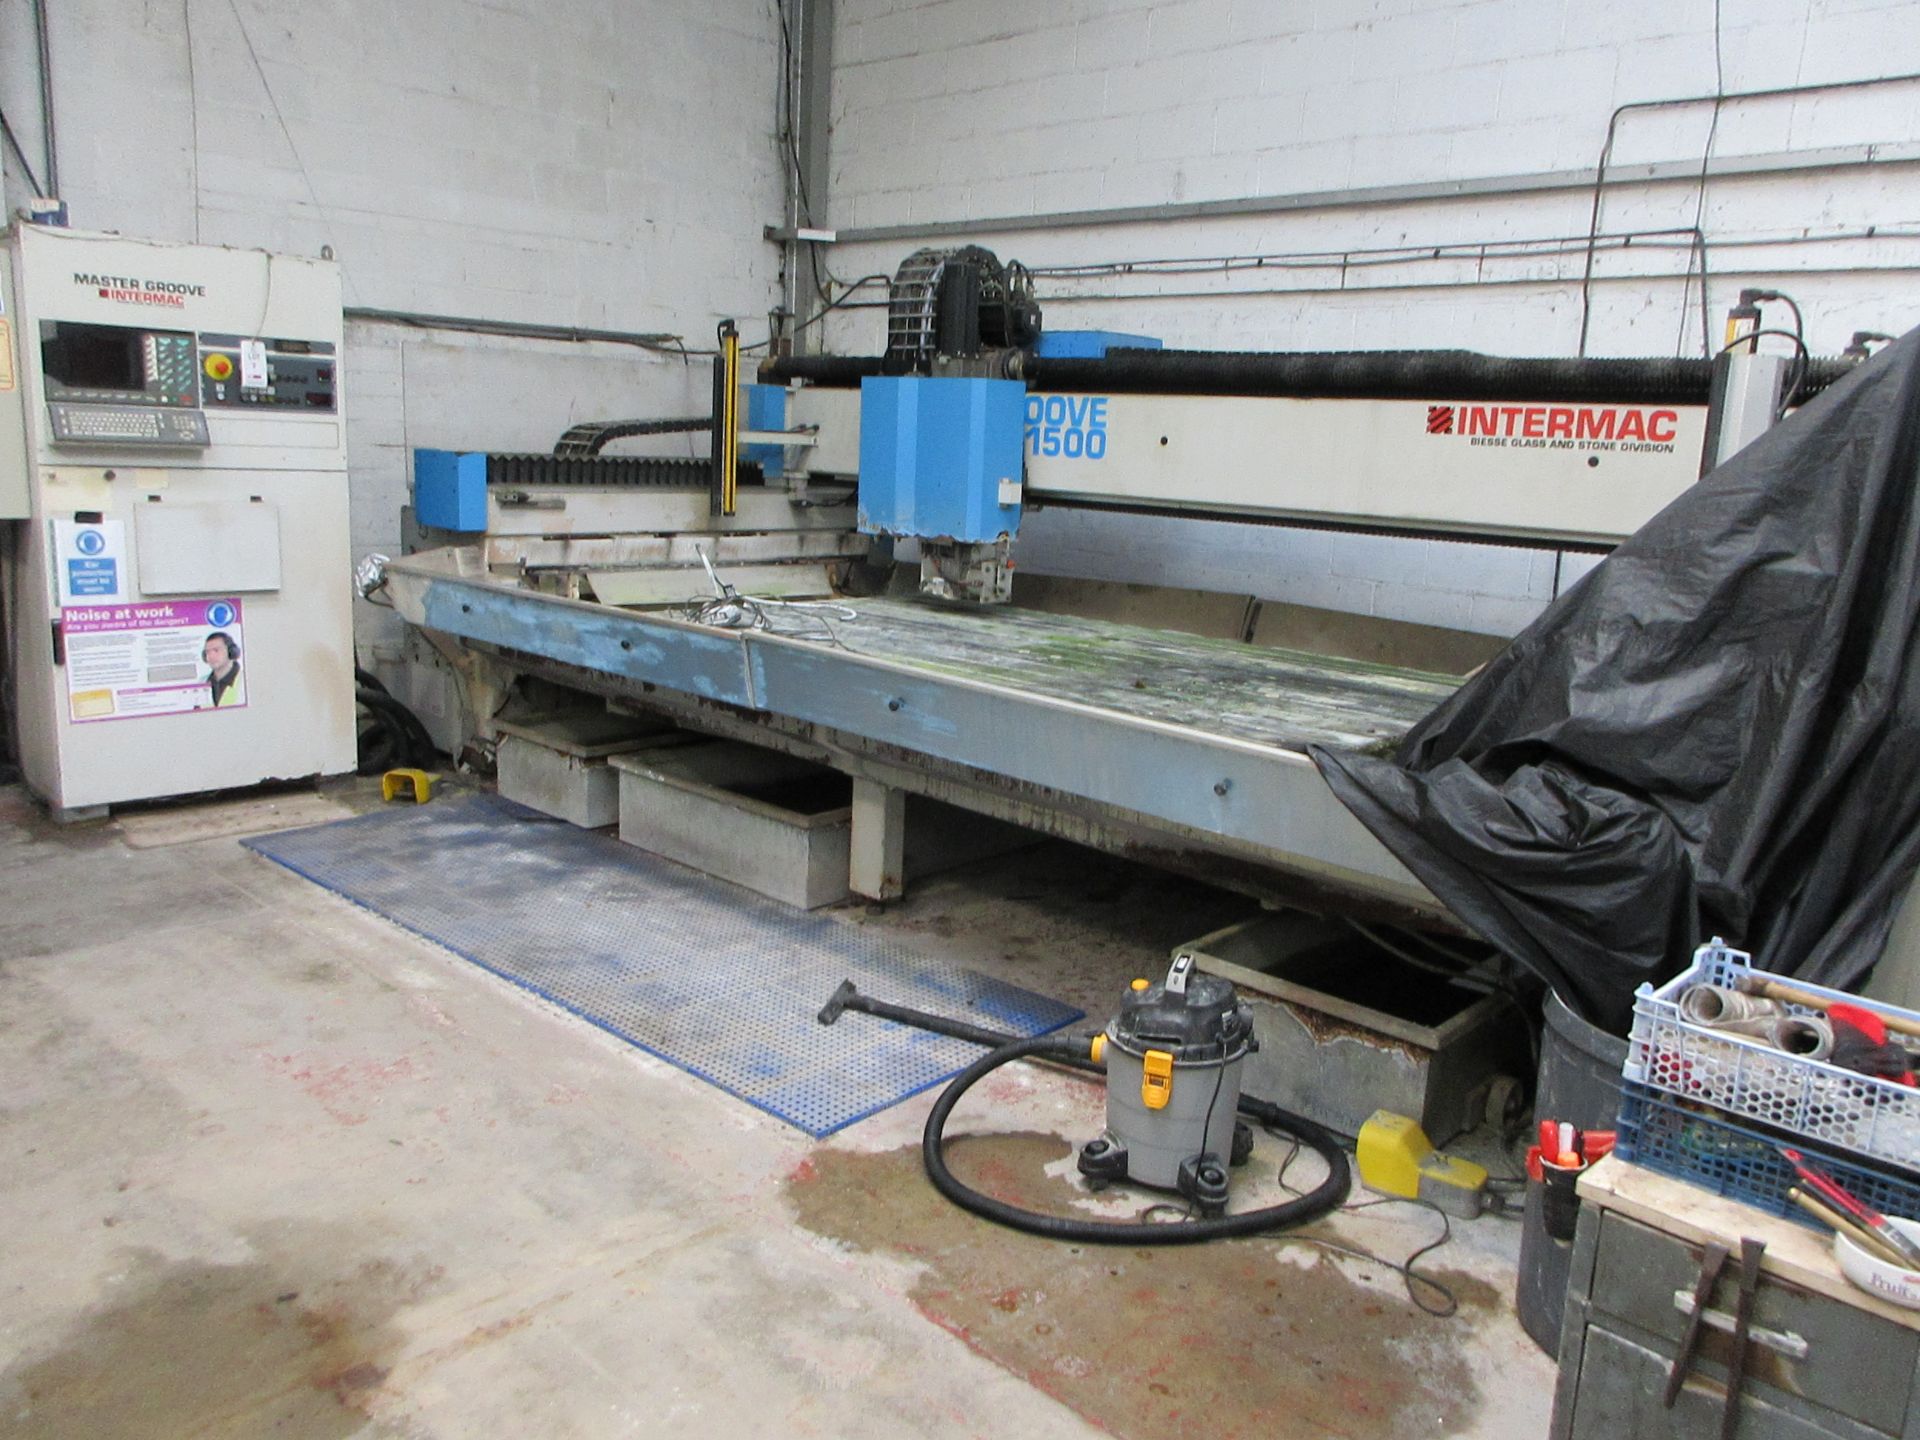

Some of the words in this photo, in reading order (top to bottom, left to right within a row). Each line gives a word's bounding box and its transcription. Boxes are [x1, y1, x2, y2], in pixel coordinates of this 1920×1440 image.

[73, 273, 139, 290] MASTER
[145, 280, 206, 297] GROOVE
[111, 289, 185, 305] INTERMAC
[1457, 406, 1678, 442] INTERMAC
[1025, 427, 1107, 459] 1500
[1470, 437, 1507, 447] BIESSE
[1511, 438, 1546, 448] GLASS
[1549, 439, 1574, 449] AND
[1578, 440, 1616, 451] STONE
[1620, 442, 1674, 453] DIVISION
[66, 609, 111, 622] Noise
[115, 609, 130, 620] at
[135, 605, 174, 618] work
